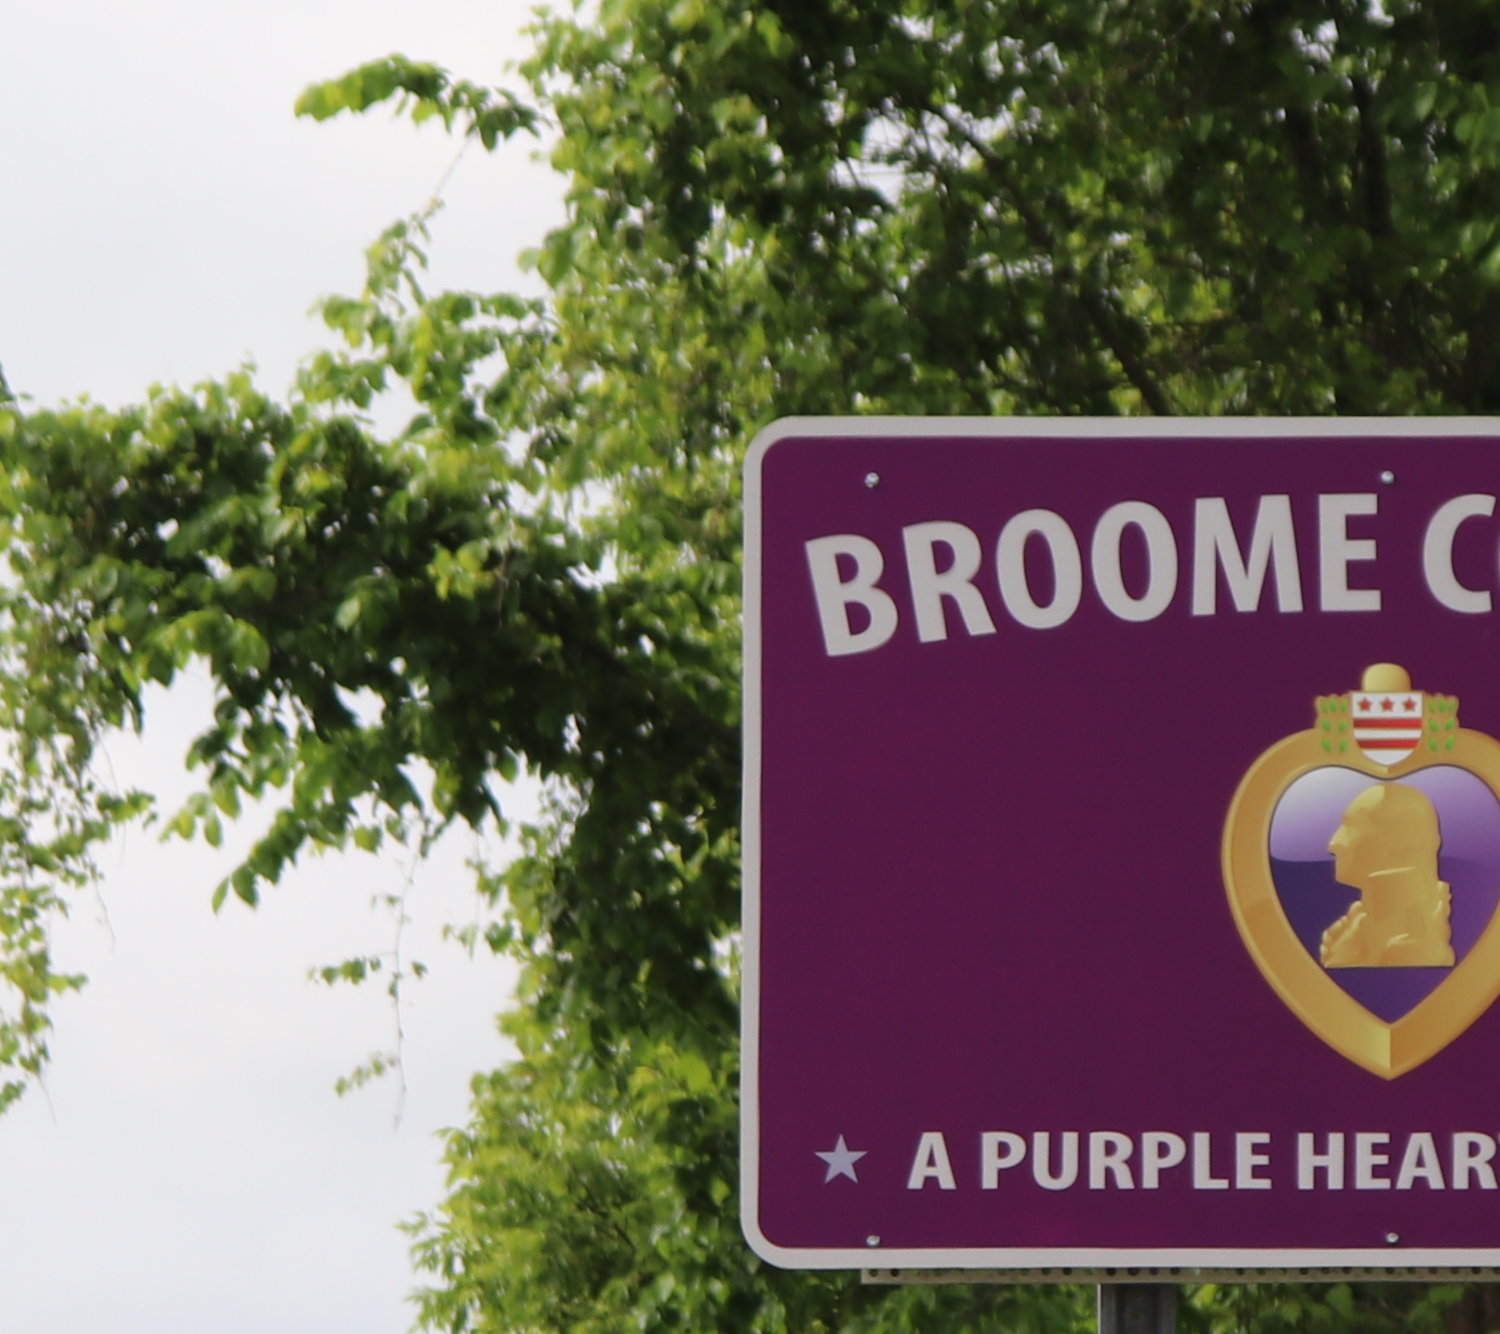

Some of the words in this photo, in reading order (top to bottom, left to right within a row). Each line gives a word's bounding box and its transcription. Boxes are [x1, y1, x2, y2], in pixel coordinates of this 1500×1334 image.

[805, 493, 1382, 657] BROOME
[907, 1131, 957, 1190] A
[981, 1131, 1272, 1190] PURPLE
